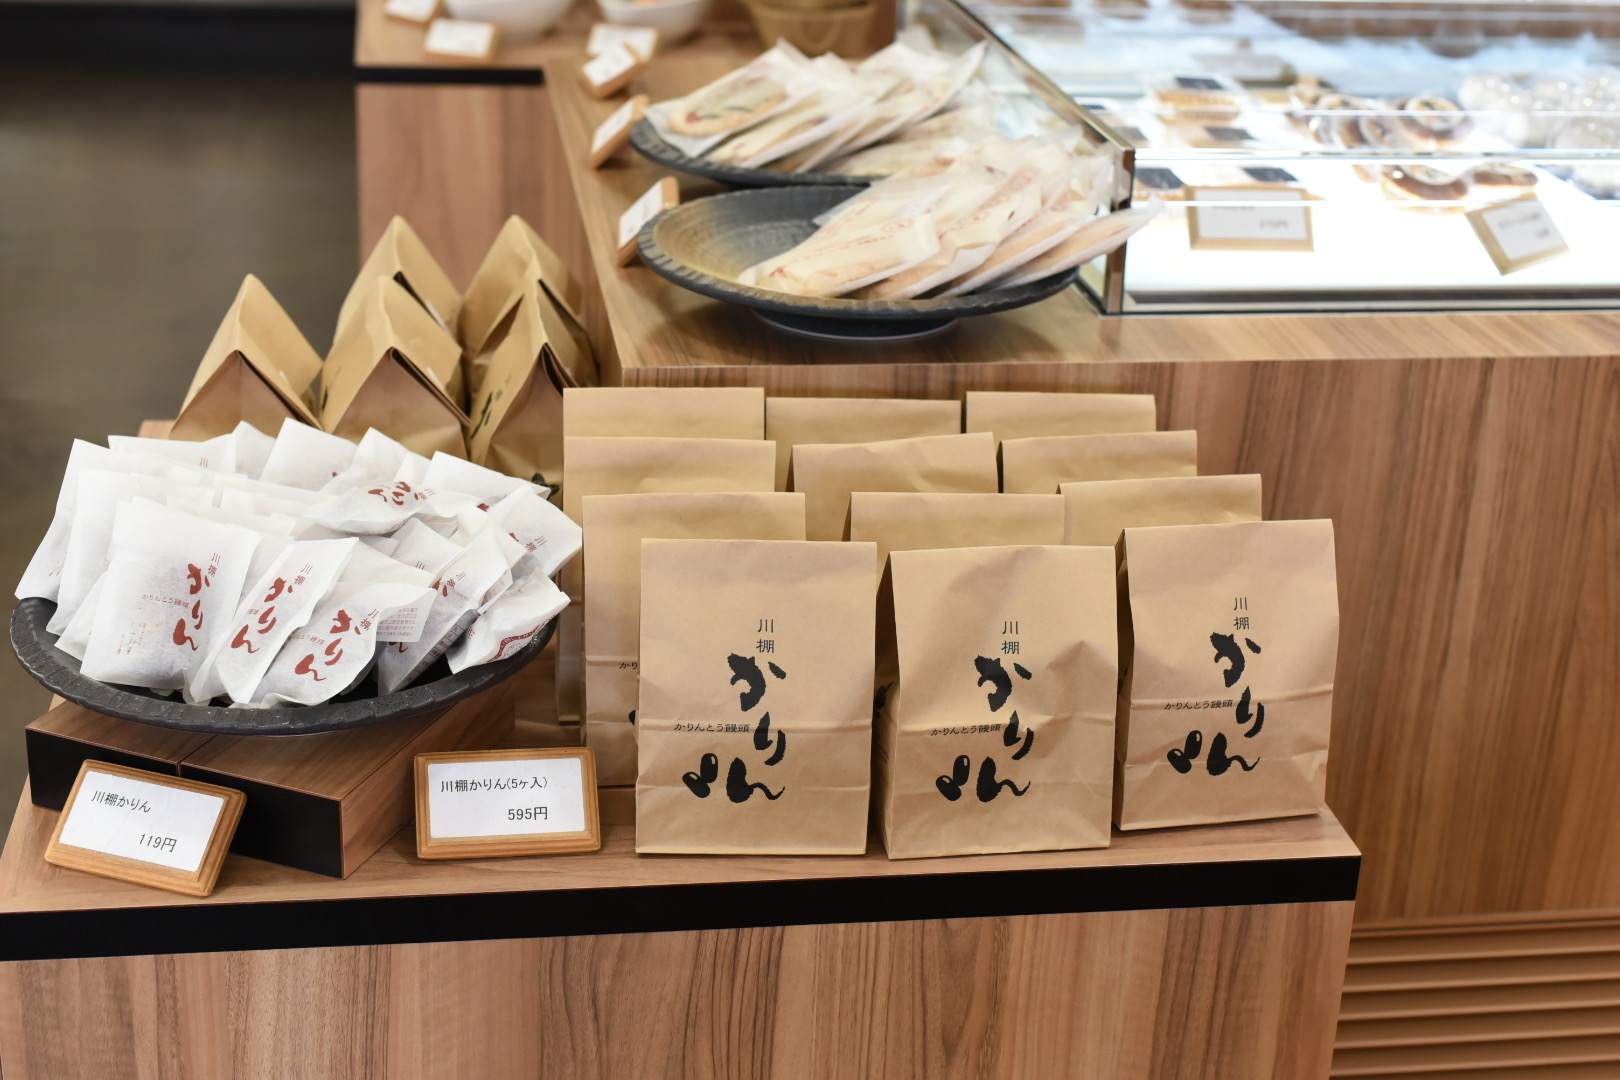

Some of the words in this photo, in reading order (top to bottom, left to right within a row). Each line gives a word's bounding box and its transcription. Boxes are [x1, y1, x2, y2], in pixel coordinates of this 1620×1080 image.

[204, 552, 221, 578] 川棚
[294, 563, 314, 586] 川棚
[172, 563, 211, 652] かりん
[230, 577, 294, 654] かりん
[1233, 597, 1250, 631] 川棚
[294, 609, 362, 682] かりん
[756, 619, 775, 653] 川棚
[1001, 620, 1020, 655] 川棚
[1163, 700, 1234, 711] かりんとう饅頭
[1207, 632, 1262, 776] かりん
[673, 722, 751, 733] かりんとう饅頭
[725, 652, 787, 804] かりん
[930, 723, 1002, 737] かりんとう饅頭
[974, 654, 1033, 803] かりん
[91, 790, 151, 813] 川棚かりん
[507, 806, 548, 821] 595円
[139, 833, 177, 853] 119円
